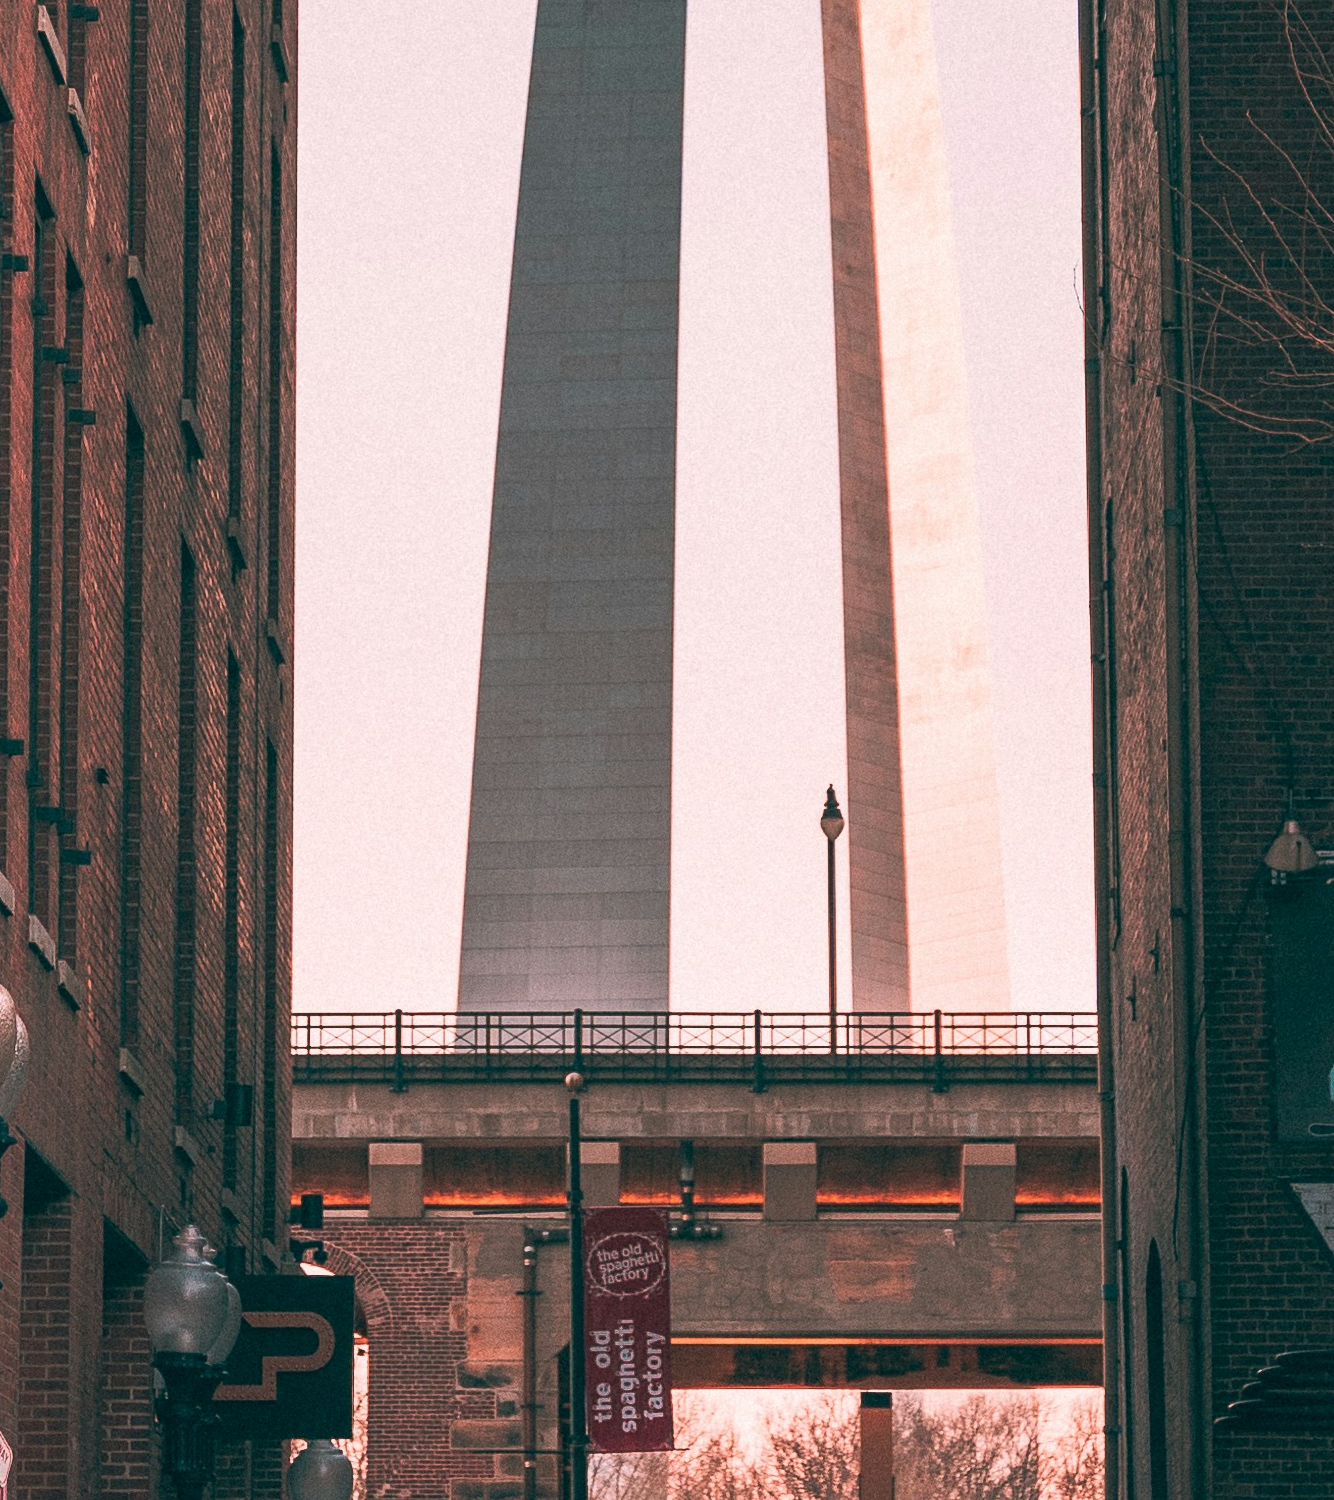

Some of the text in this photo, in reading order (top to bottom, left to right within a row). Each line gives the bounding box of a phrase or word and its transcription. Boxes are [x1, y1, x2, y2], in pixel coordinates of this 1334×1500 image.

[596, 1243, 643, 1263] the old
[598, 1250, 660, 1276] spaghetti
[601, 1266, 650, 1286] factory
[590, 1330, 612, 1423] the old
[615, 1319, 640, 1433] spaghetti
[642, 1331, 666, 1420] factory
